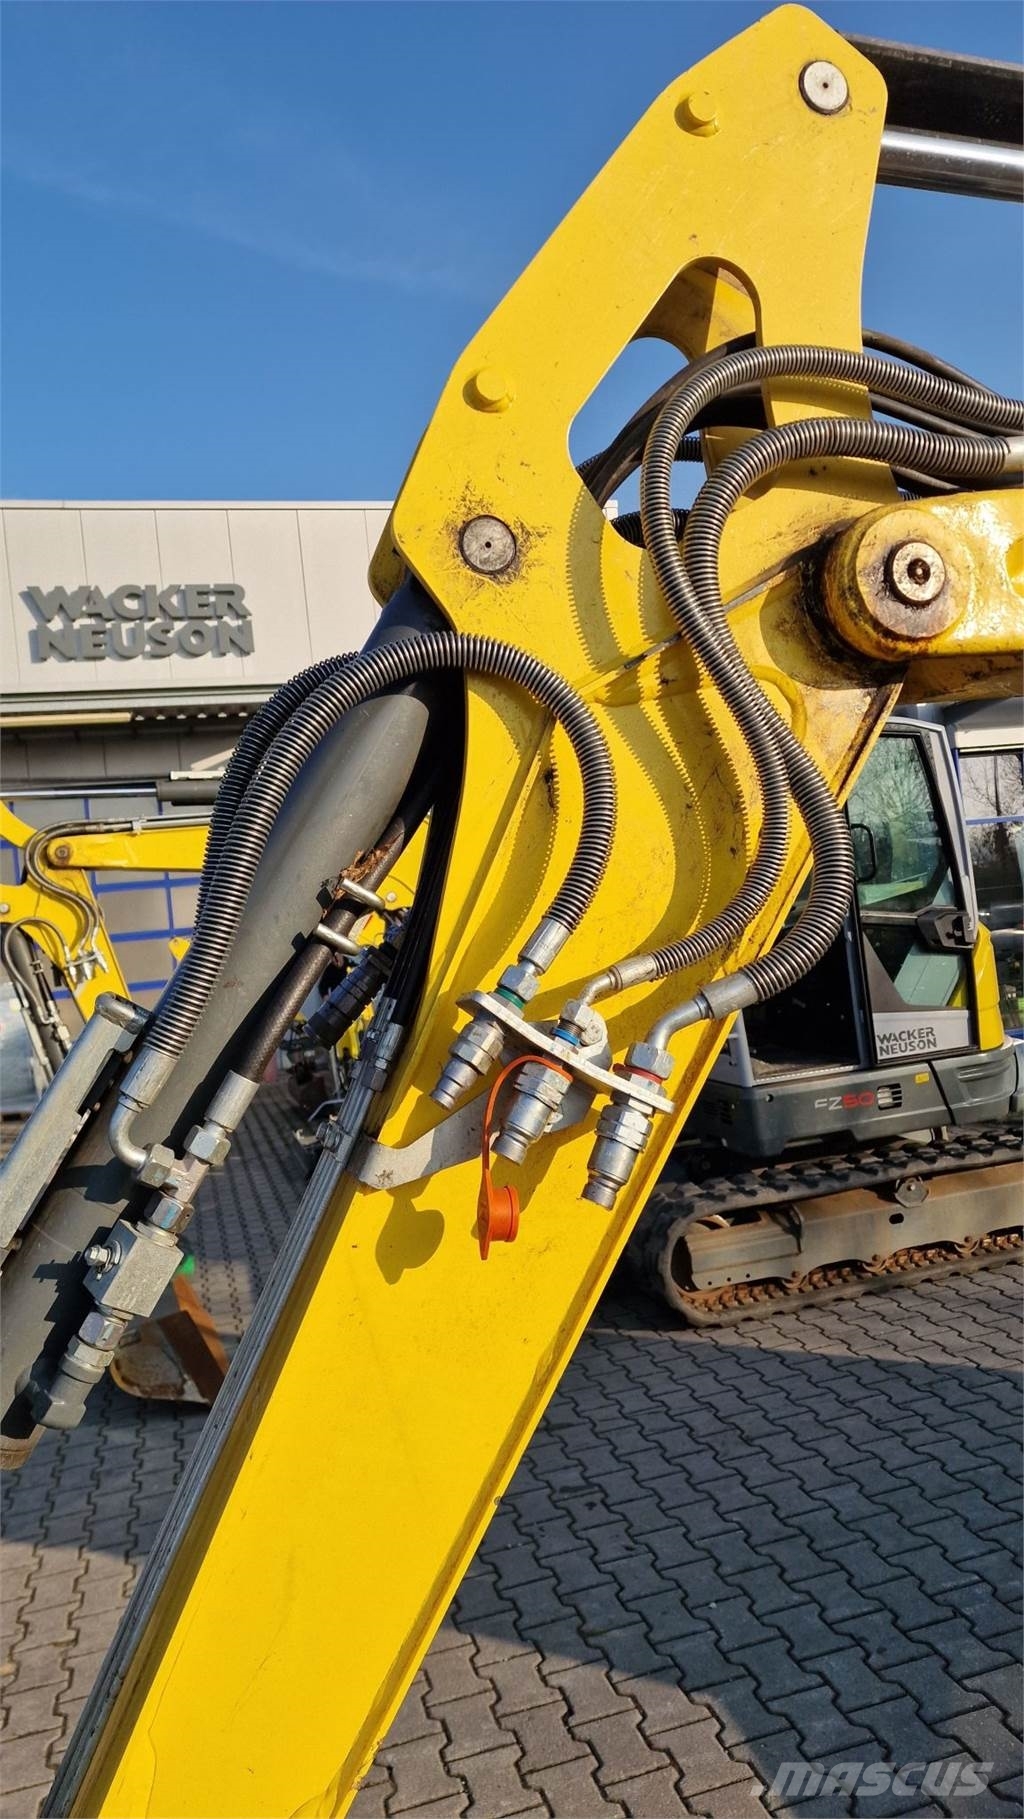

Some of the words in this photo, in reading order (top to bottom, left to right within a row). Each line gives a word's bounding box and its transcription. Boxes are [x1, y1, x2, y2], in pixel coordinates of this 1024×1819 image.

[24, 584, 252, 622] WACKER
[35, 620, 255, 661] NEUSON
[877, 1027, 936, 1044] WACKER
[879, 1038, 937, 1056] NEUSON
